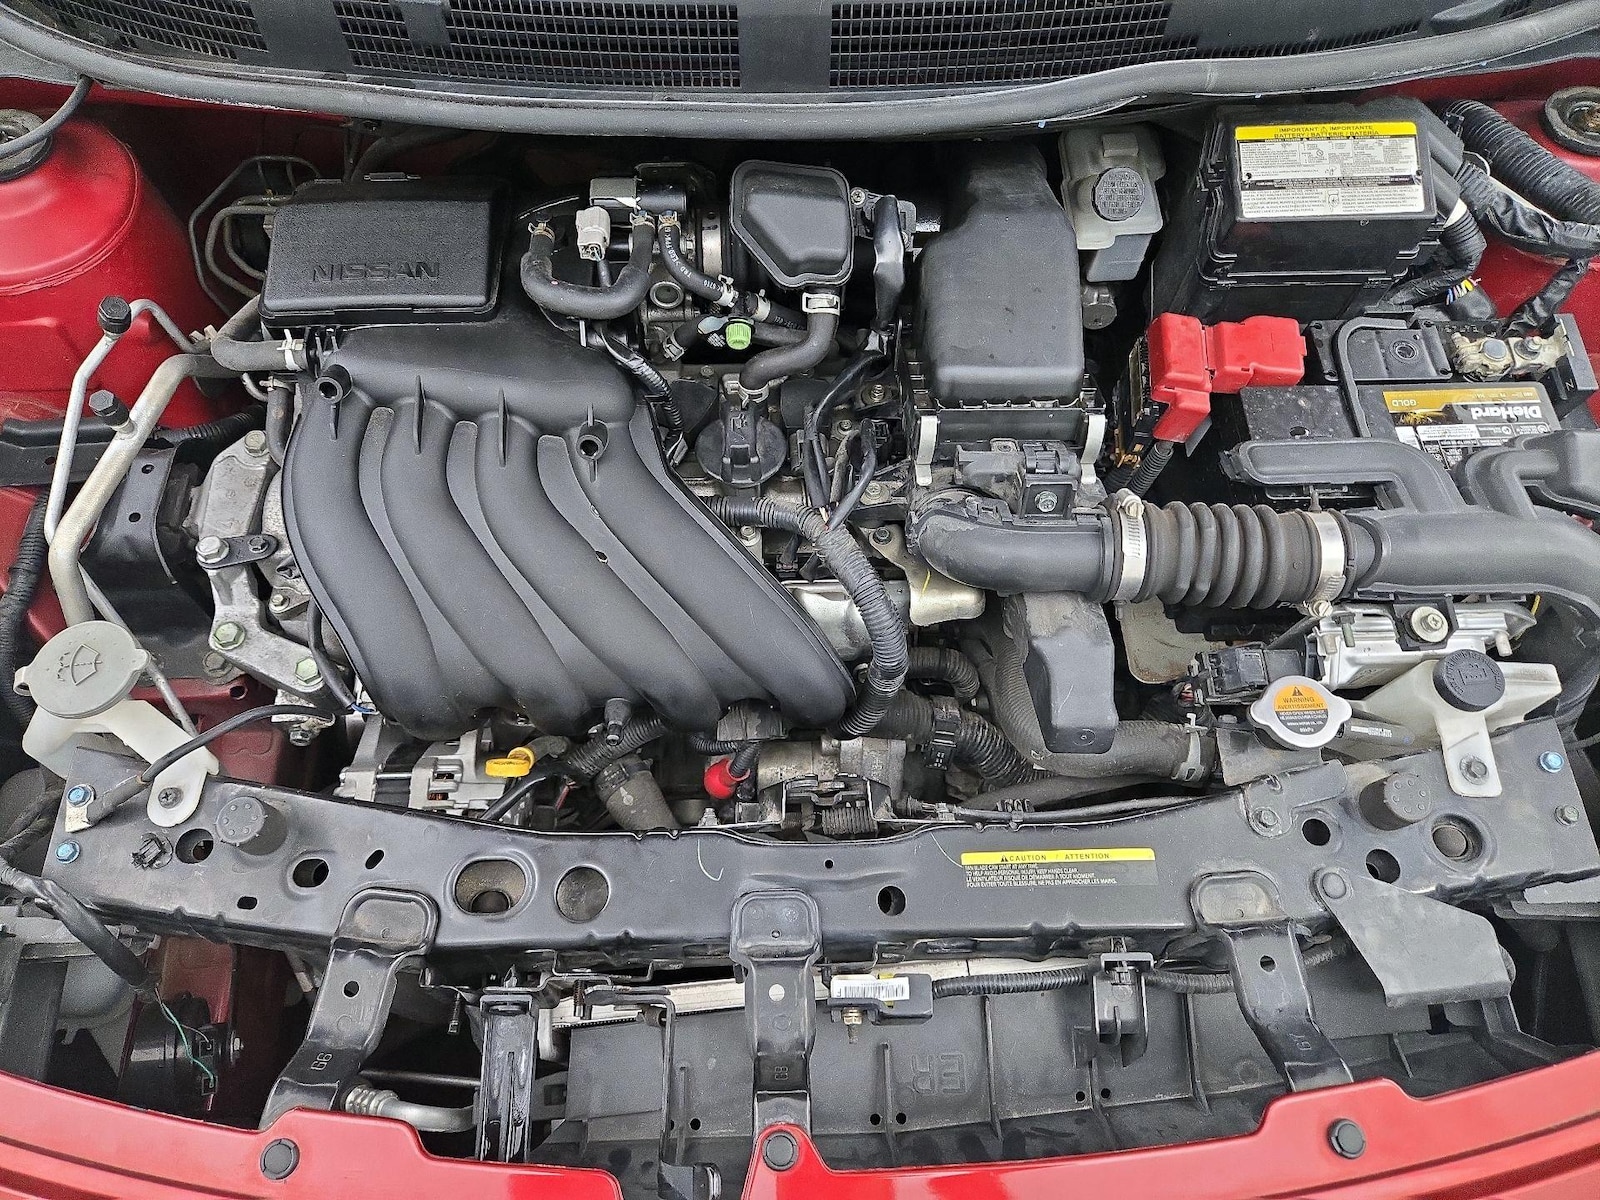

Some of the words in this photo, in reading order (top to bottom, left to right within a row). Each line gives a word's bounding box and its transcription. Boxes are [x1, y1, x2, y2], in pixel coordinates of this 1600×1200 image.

[313, 261, 440, 281] NISSAN
[1470, 406, 1542, 420] DieHard
[911, 1052, 968, 1096] ER
